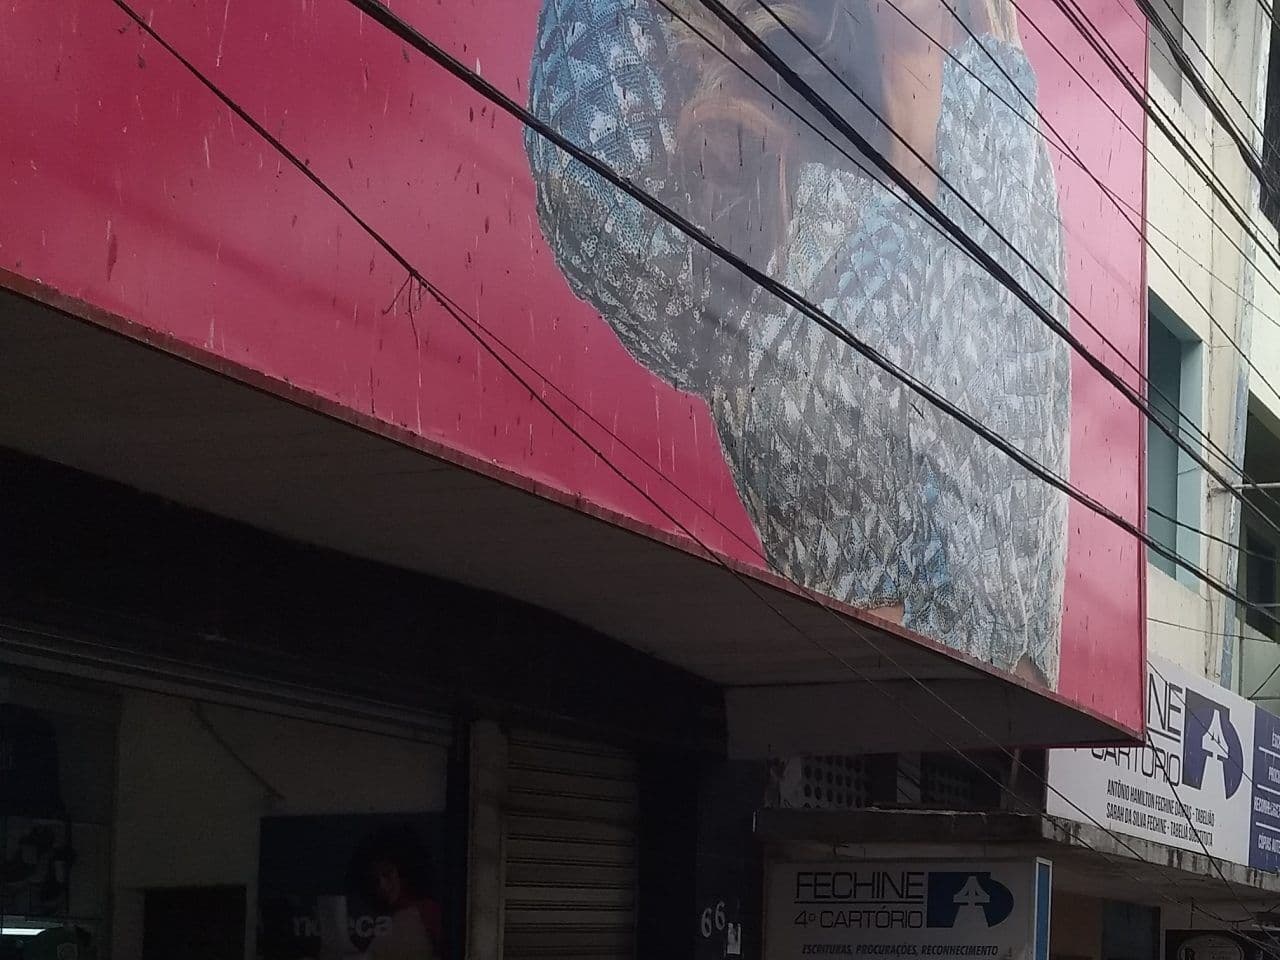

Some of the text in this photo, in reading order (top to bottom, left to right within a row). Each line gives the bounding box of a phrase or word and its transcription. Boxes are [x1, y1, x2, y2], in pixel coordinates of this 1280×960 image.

[1106, 778, 1130, 801] ANTÔNIO
[1130, 785, 1155, 808] HAMILTON
[1155, 791, 1175, 814] FECHINE
[1195, 806, 1215, 827] TABELIÃO
[1106, 802, 1125, 822] SARAH
[1124, 808, 1132, 825] DA
[1132, 811, 1147, 829] SILVA
[1147, 814, 1167, 835] FECHINE
[795, 872, 924, 899] FECHINE
[794, 905, 923, 929] 4º CARTÓRIO
[921, 945, 998, 956] RECONHECIMENTO
